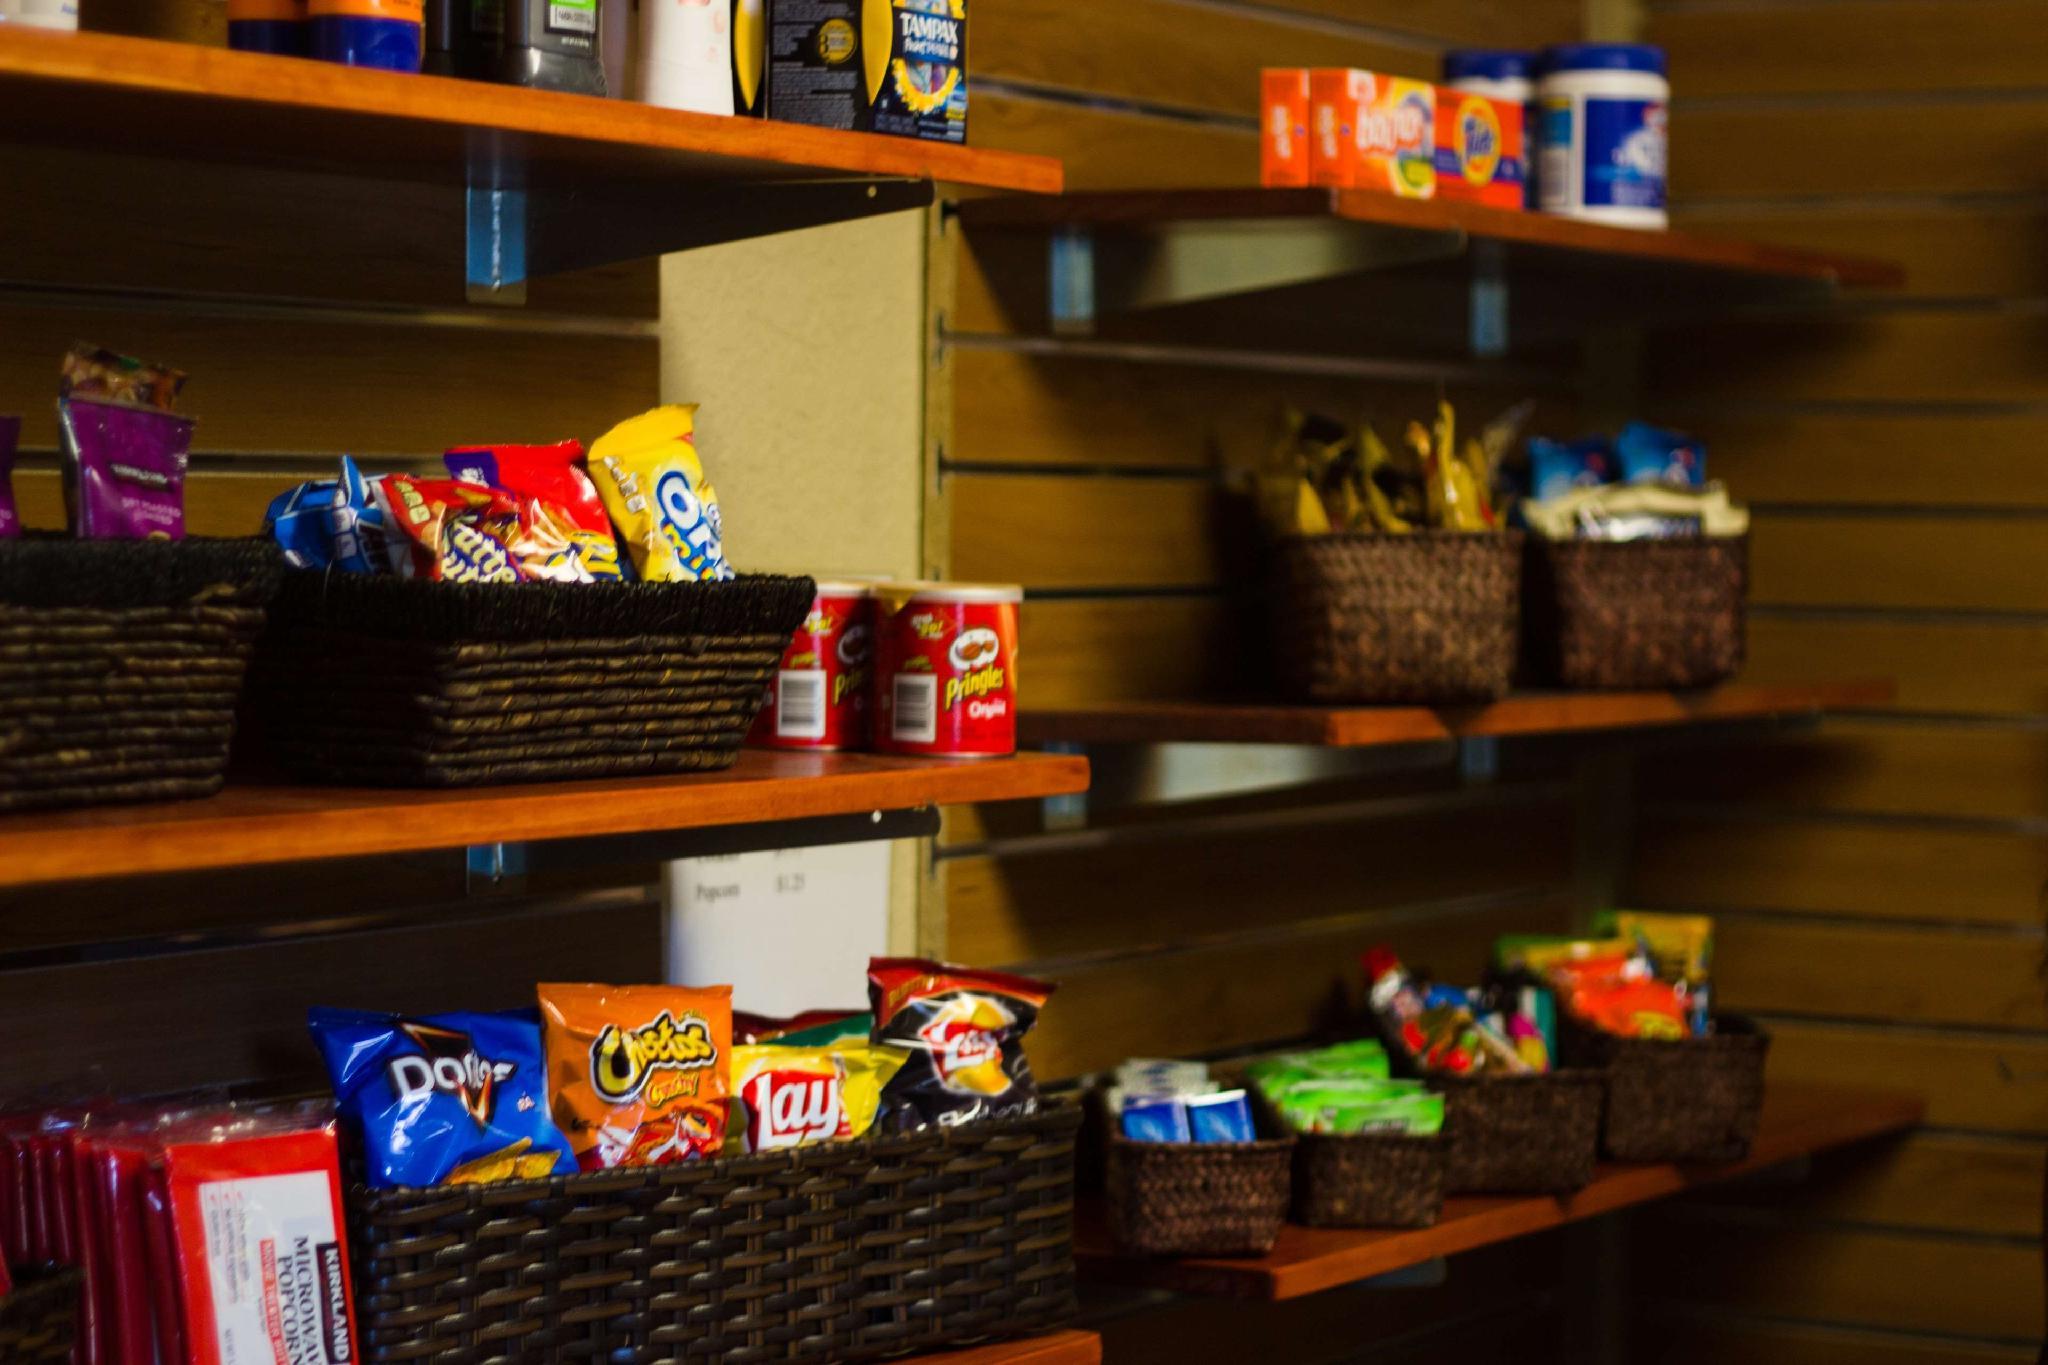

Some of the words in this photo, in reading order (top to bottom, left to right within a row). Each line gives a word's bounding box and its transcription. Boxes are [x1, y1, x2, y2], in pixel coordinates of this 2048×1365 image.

[899, 12, 958, 45] TAMPAX
[944, 663, 1004, 712] Pringles
[594, 1012, 714, 1100] Cheetos
[295, 1235, 320, 1365] MICROWAV
[325, 1249, 349, 1361] KIRKLAND
